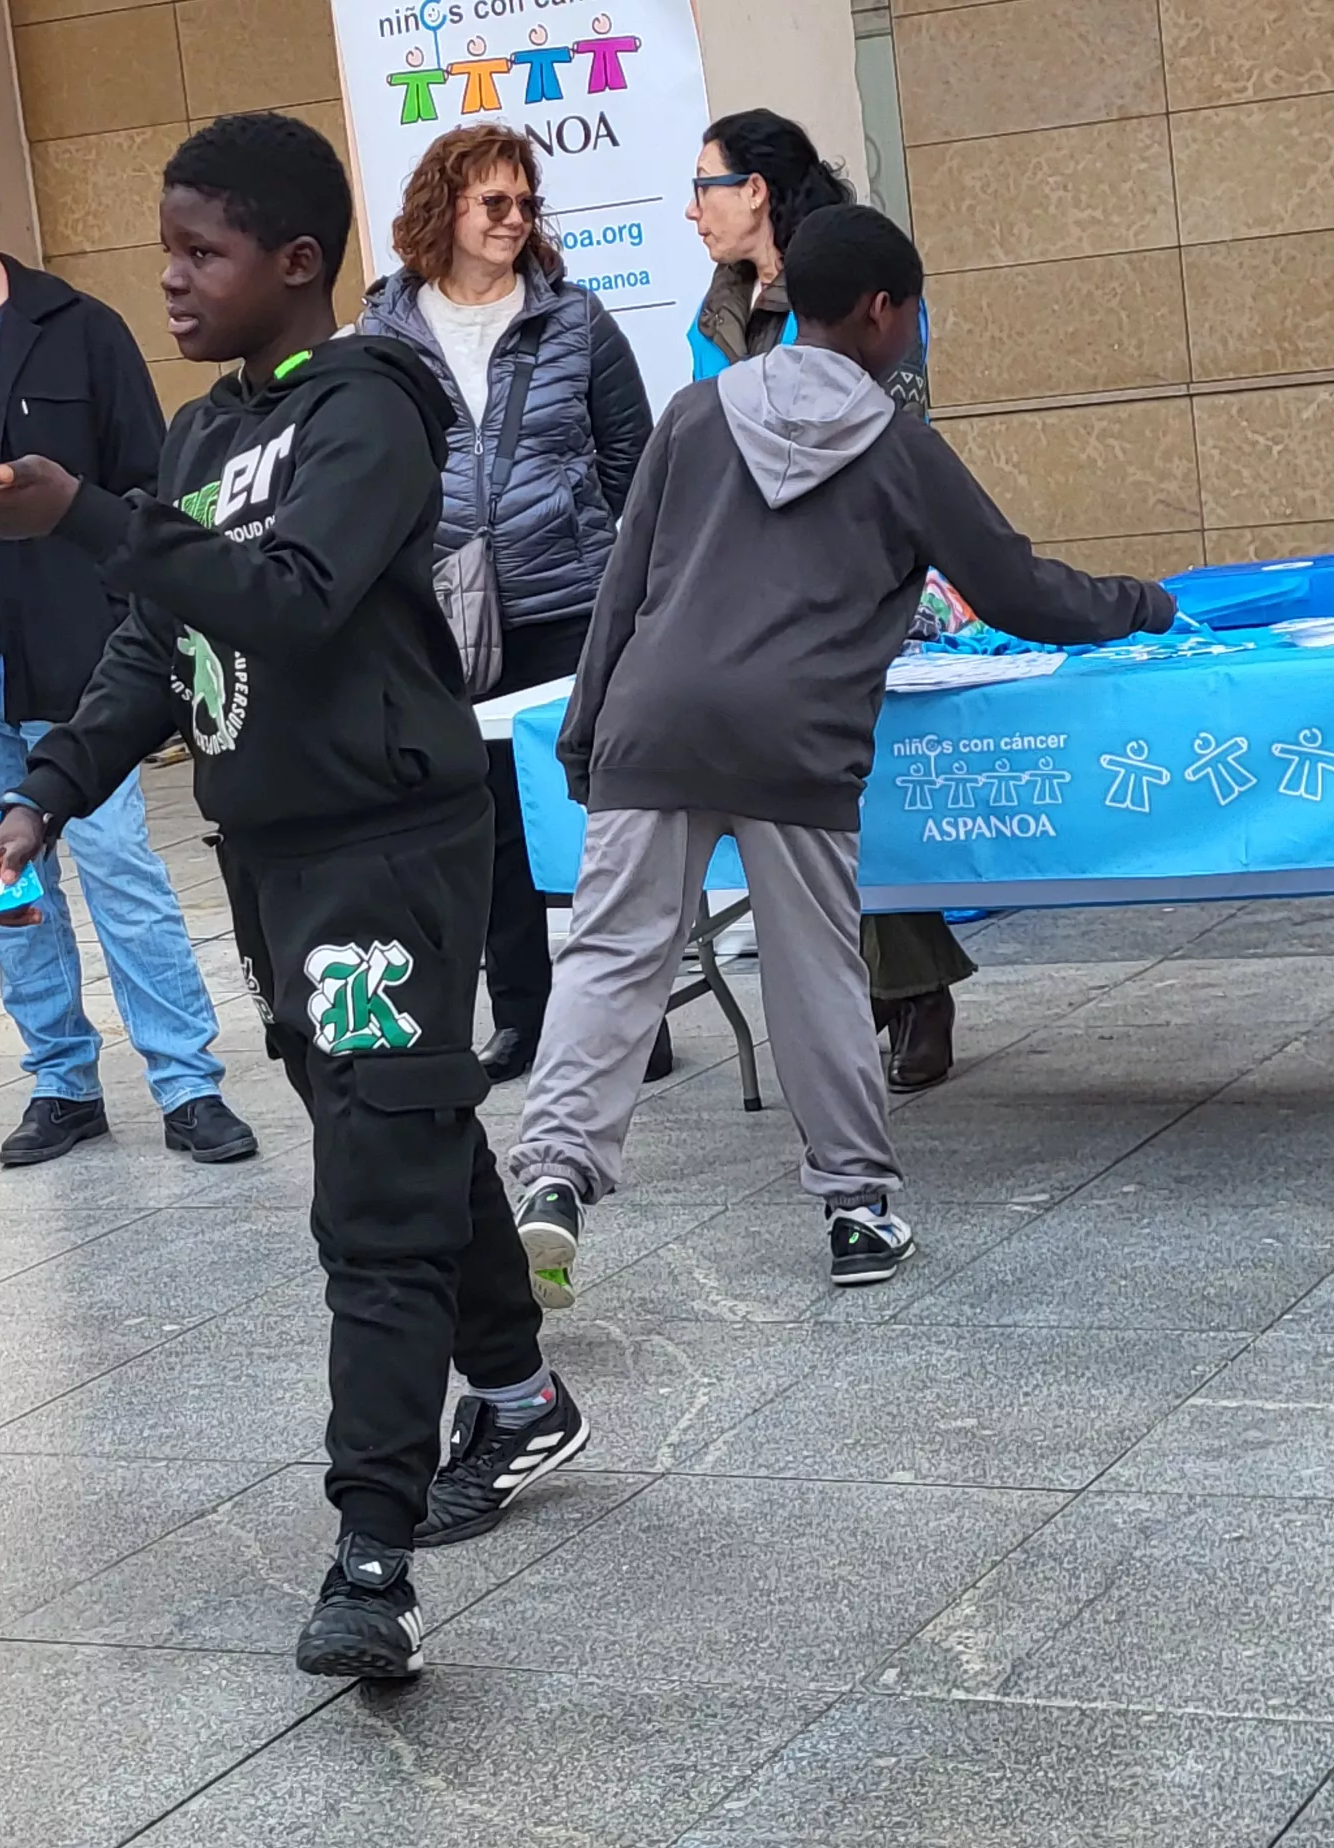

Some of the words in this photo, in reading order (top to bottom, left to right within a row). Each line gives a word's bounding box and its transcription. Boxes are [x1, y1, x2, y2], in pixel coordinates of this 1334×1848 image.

[960, 738, 995, 753] con
[1000, 732, 1067, 752] cáncer
[923, 813, 1057, 842] ASPANOA
